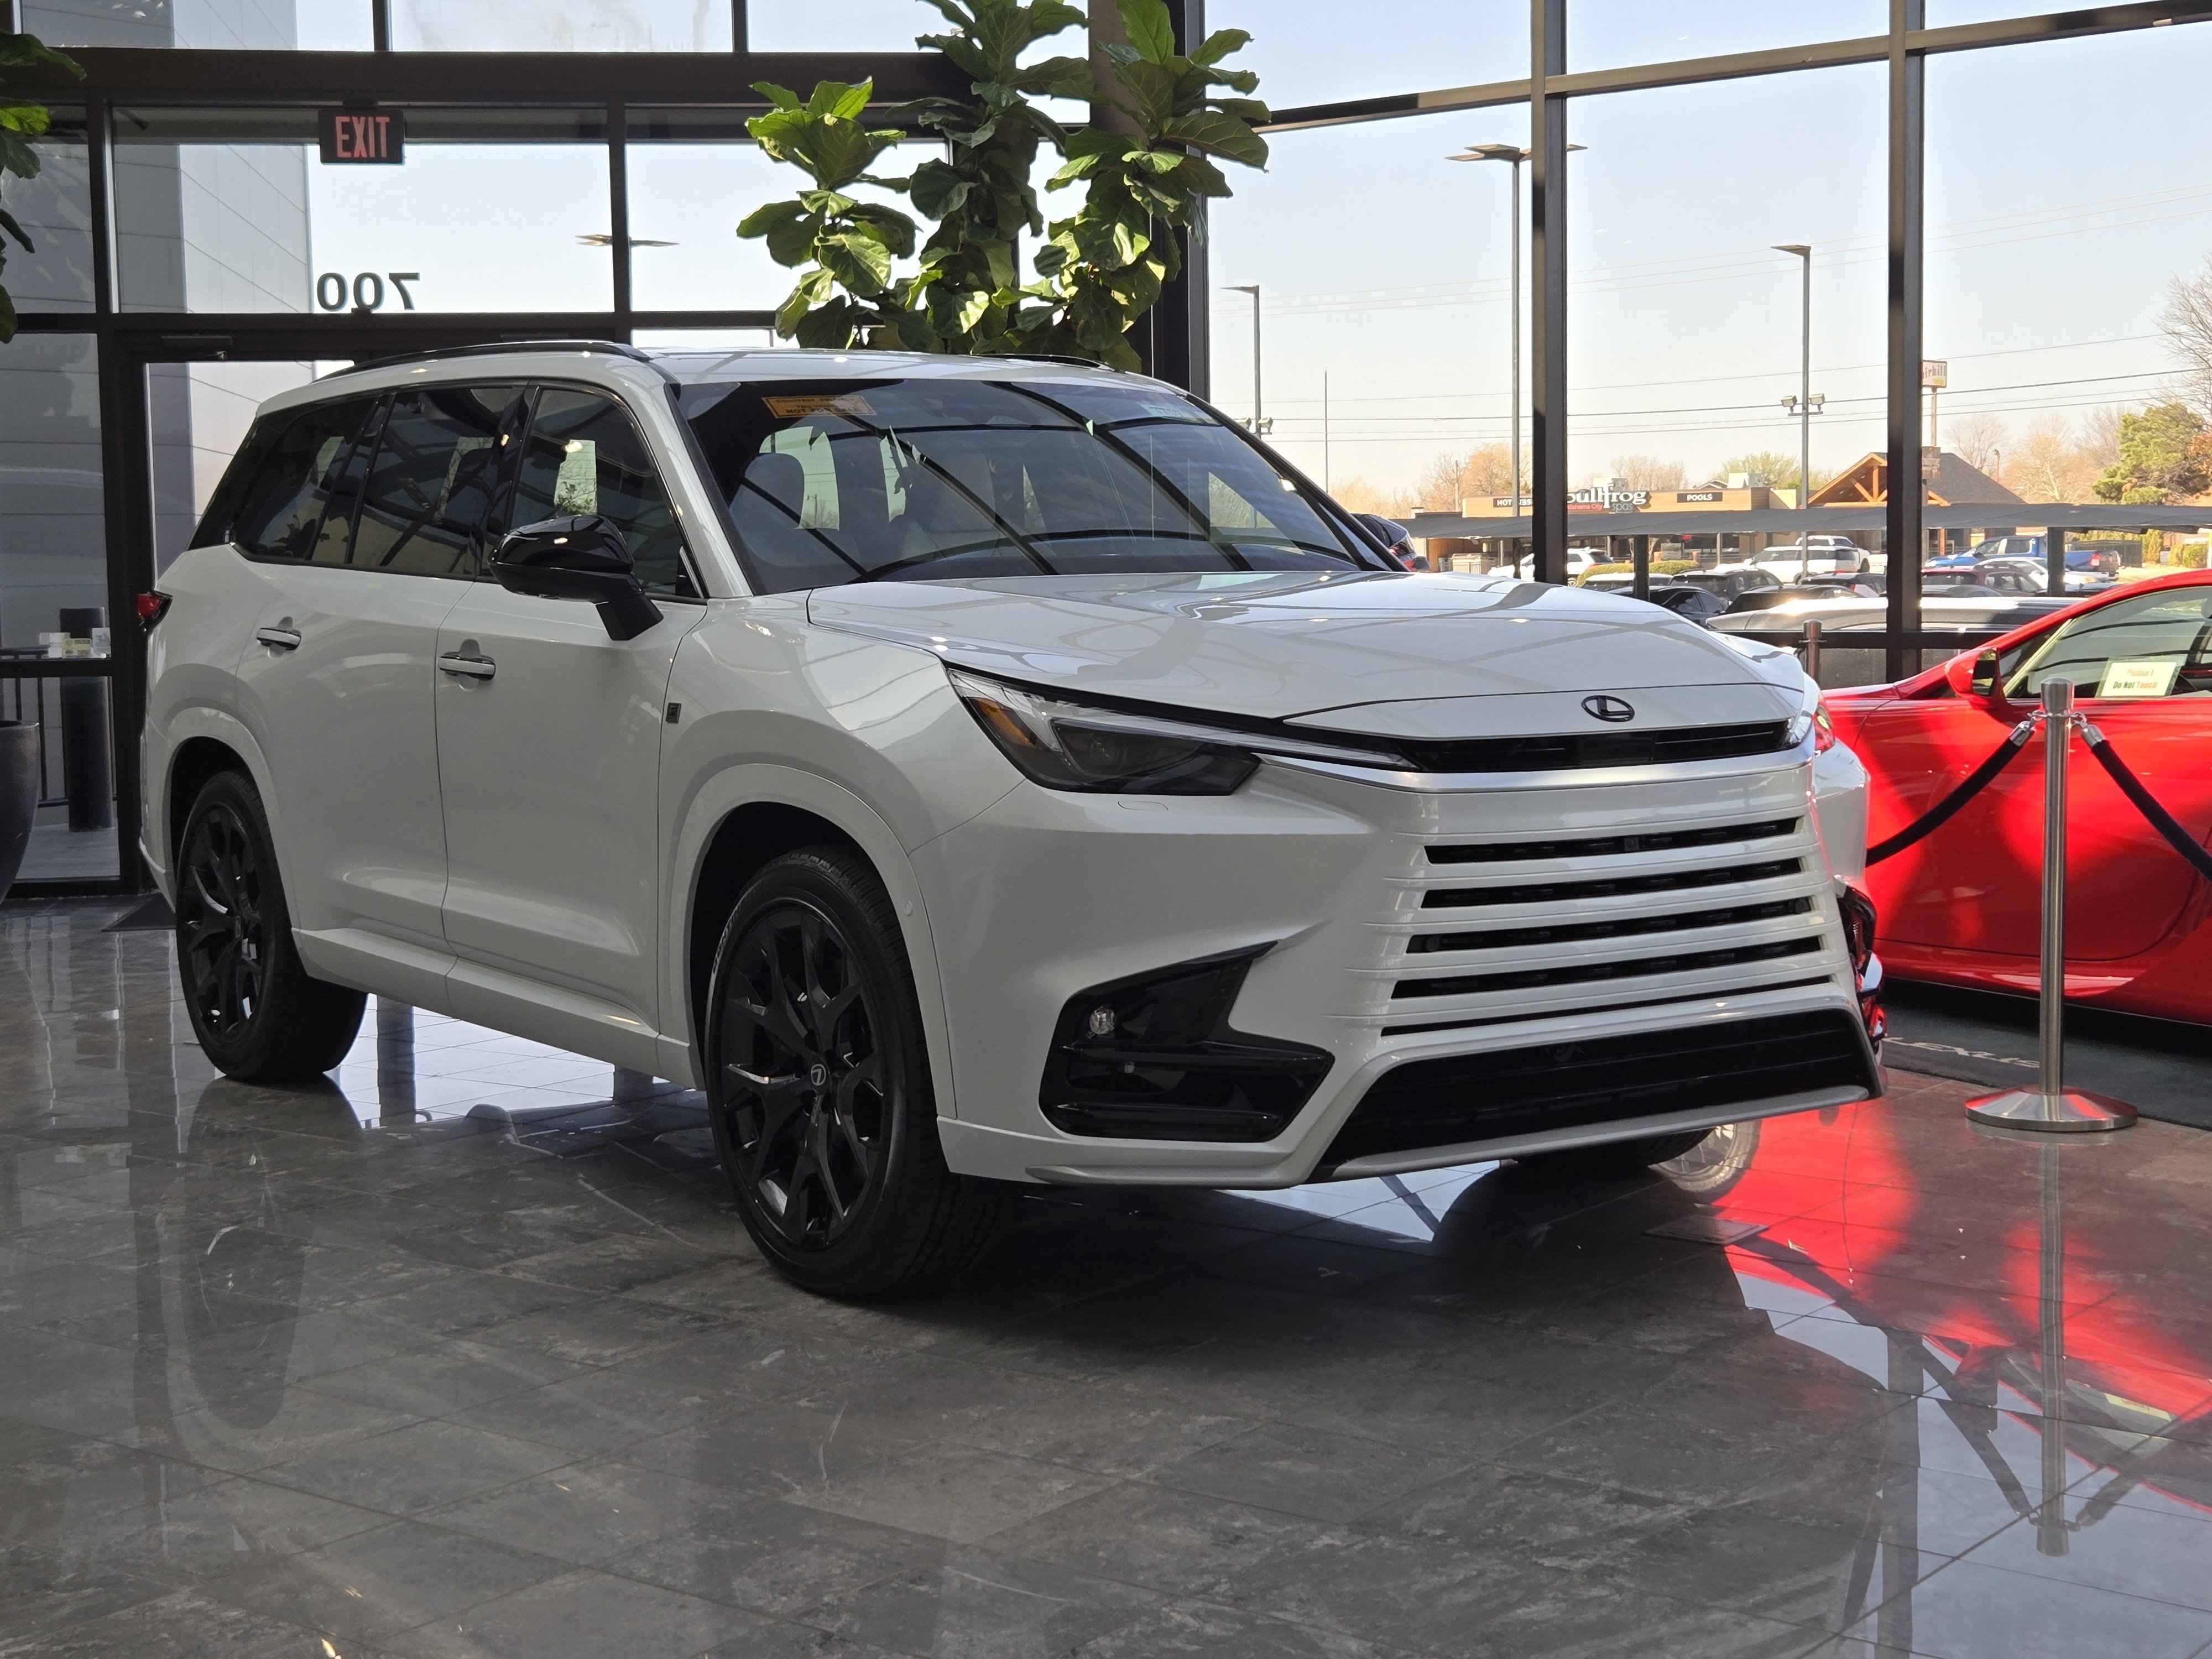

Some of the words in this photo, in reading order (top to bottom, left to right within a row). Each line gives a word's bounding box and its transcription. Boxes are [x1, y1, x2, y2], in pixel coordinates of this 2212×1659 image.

[336, 116, 390, 158] EXIT
[1922, 364, 1946, 378] irhill
[1611, 502, 1632, 513] spas
[2112, 681, 2122, 689] Do
[2122, 681, 2136, 689] Not
[2136, 681, 2157, 689] Touch
[1881, 1037, 2040, 1068] LEXUS
